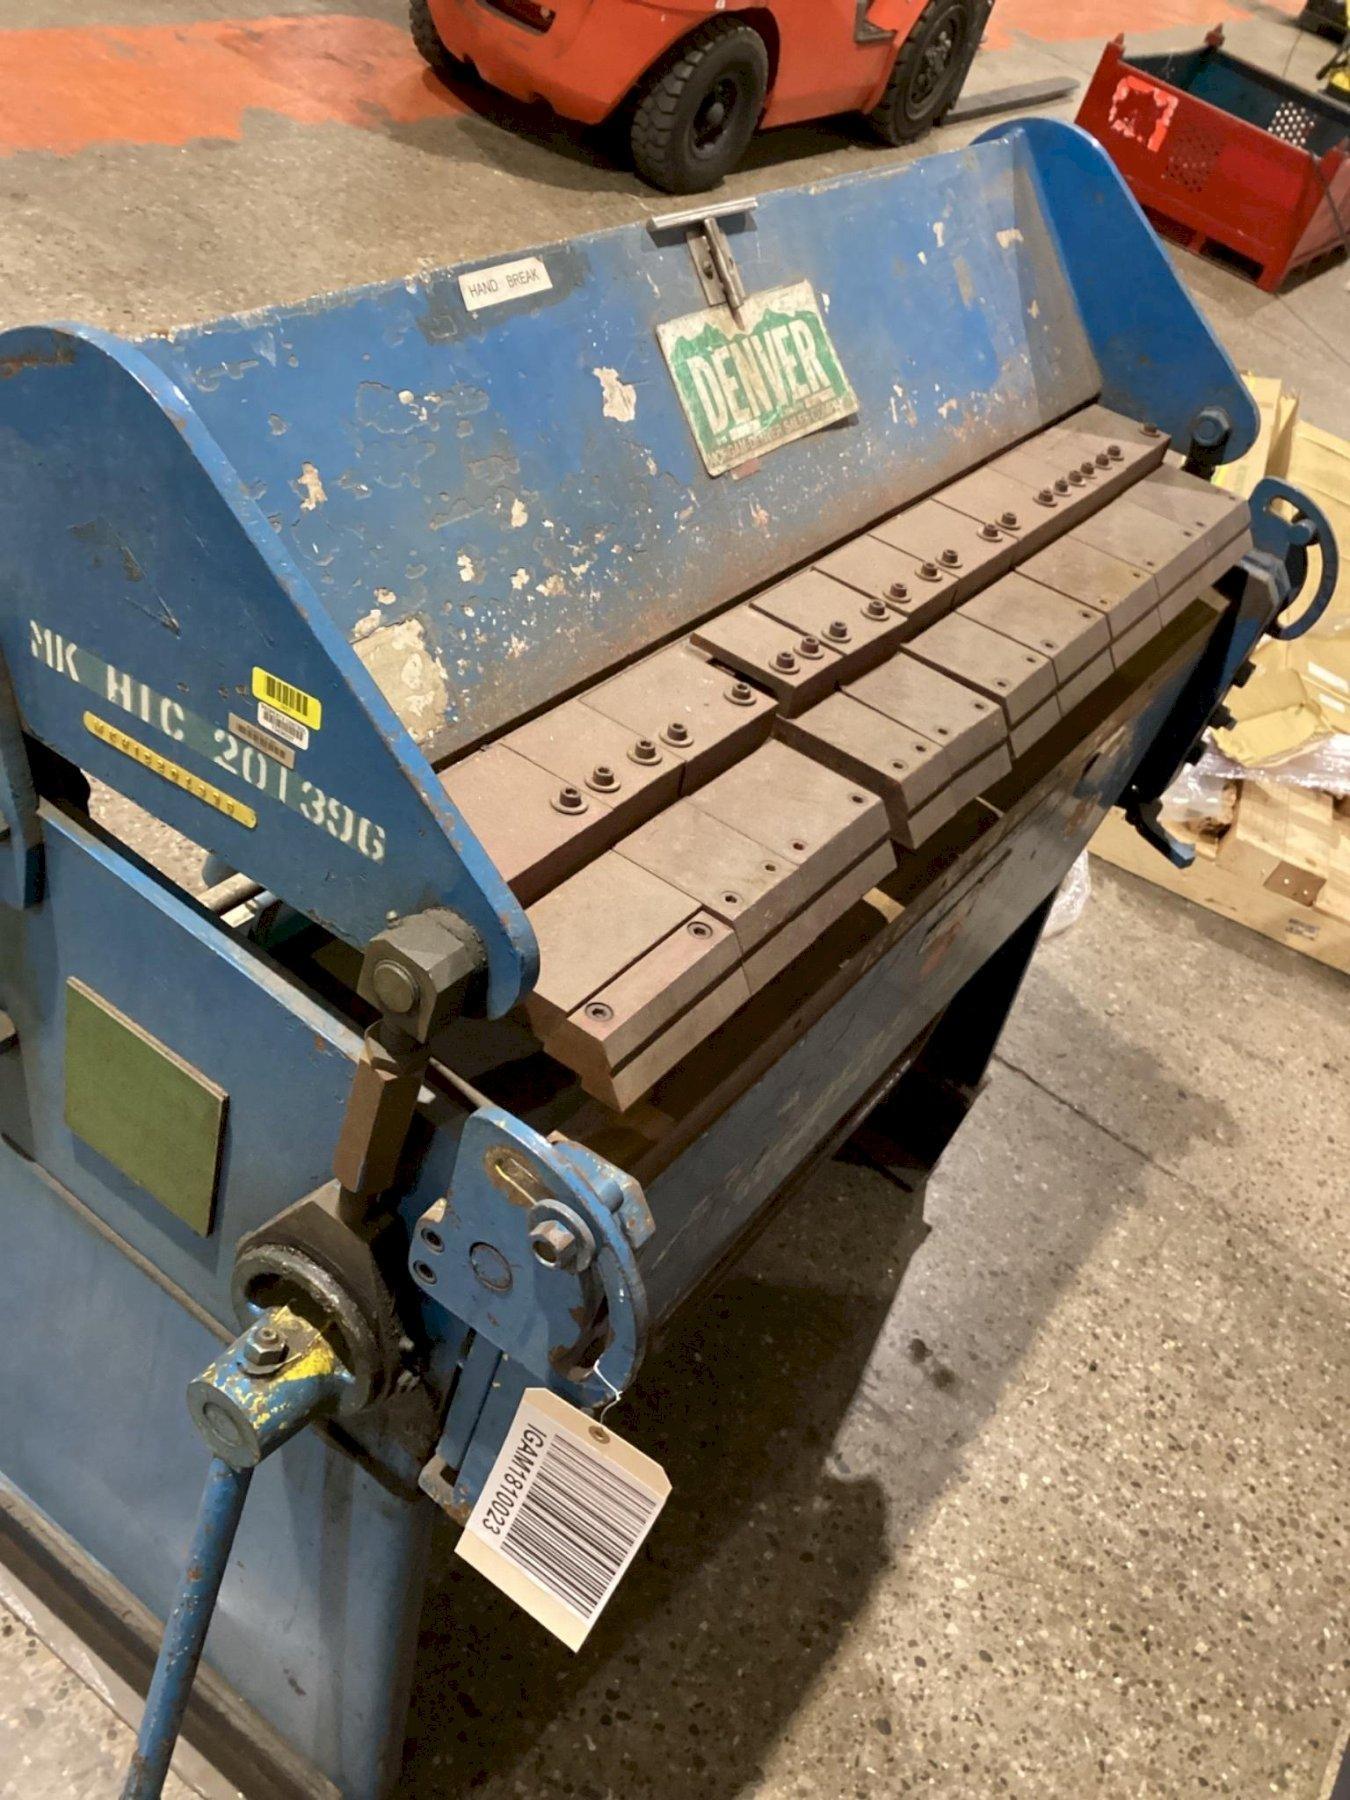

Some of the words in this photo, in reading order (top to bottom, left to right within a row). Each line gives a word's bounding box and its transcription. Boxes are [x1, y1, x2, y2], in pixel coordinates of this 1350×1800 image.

[468, 279, 499, 298] HAND
[506, 268, 540, 289] BREAK
[686, 319, 832, 435] DENVER
[29, 619, 80, 683] MK
[106, 663, 186, 741] HIC
[213, 729, 386, 862] 201396
[483, 1422, 547, 1536] IGAM1810023
